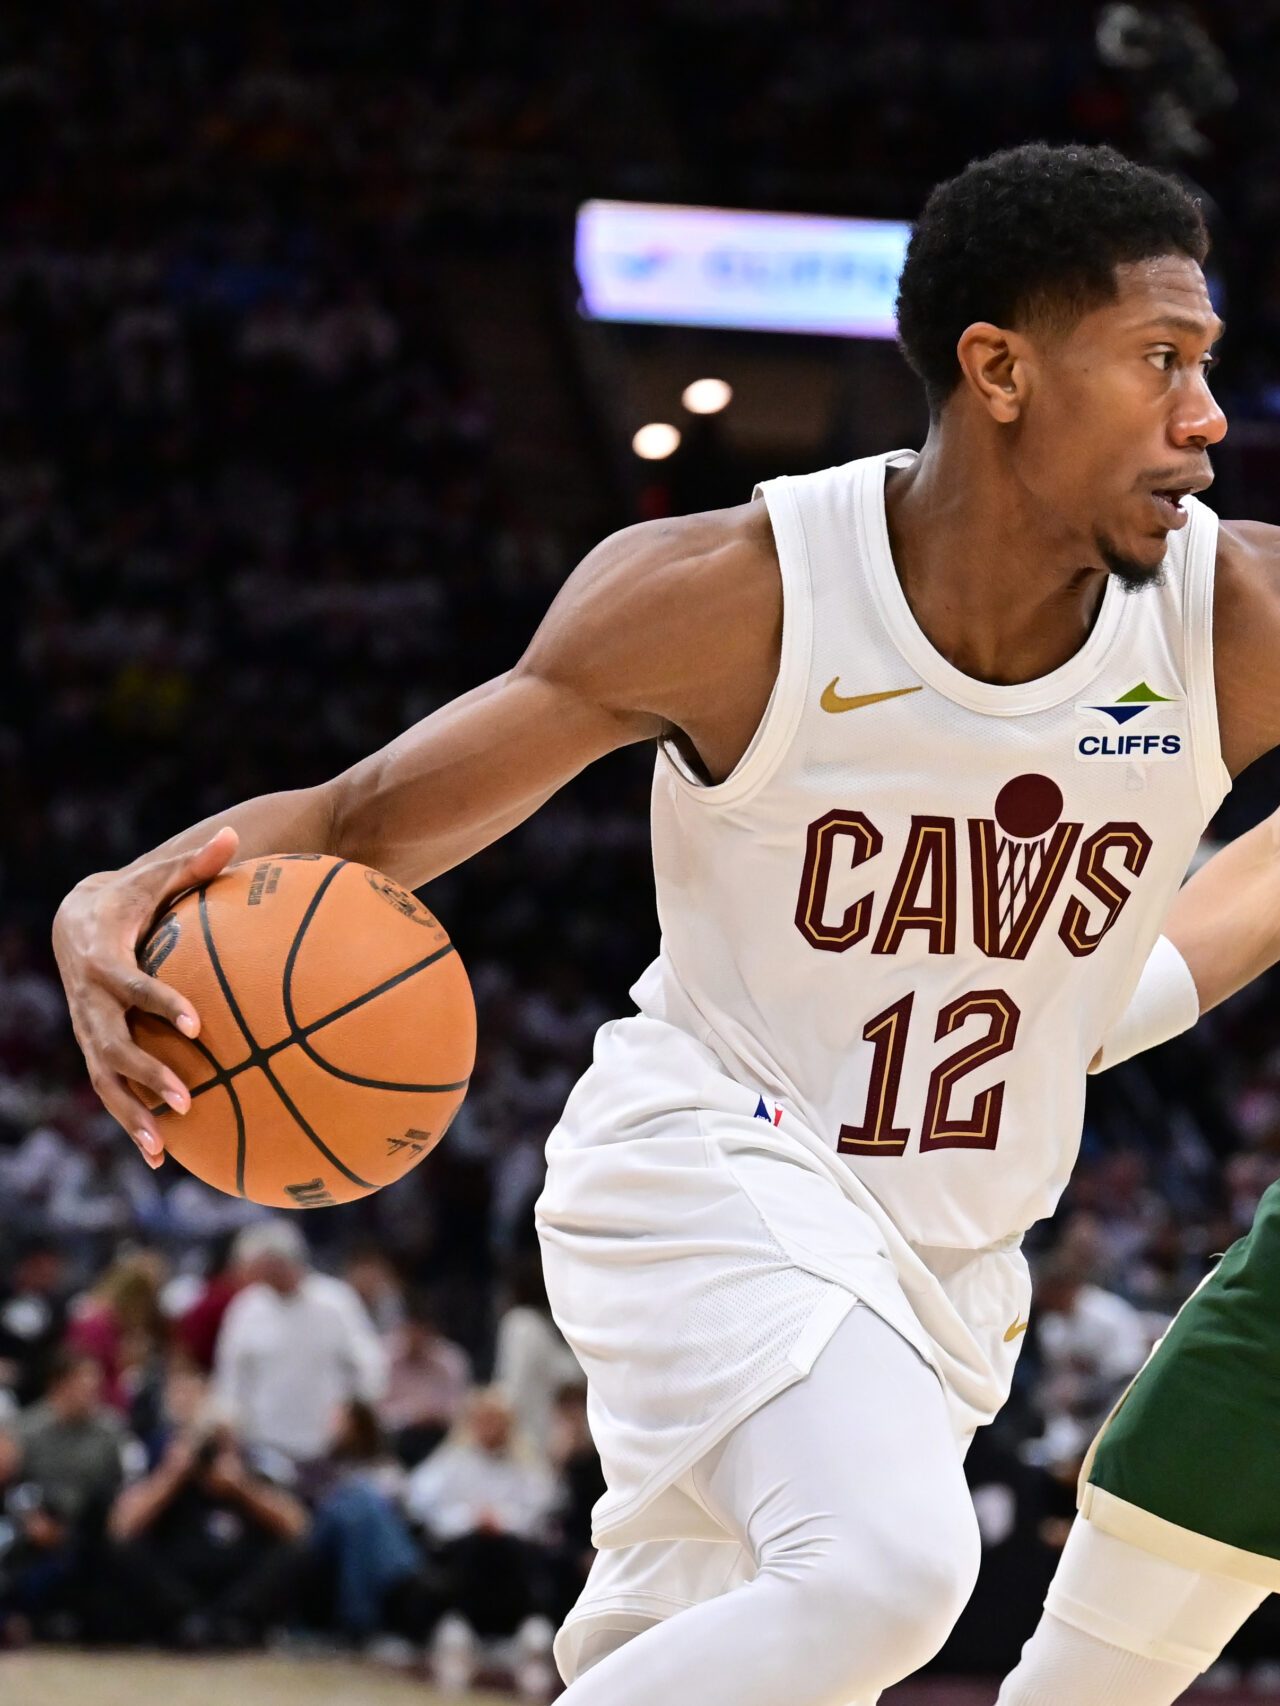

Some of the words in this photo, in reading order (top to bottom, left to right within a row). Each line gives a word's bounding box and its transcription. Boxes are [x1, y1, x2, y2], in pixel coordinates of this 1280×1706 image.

[1078, 734, 1181, 756] CLIFFS
[794, 808, 1154, 960] CAVS
[837, 988, 1021, 1157] 12
